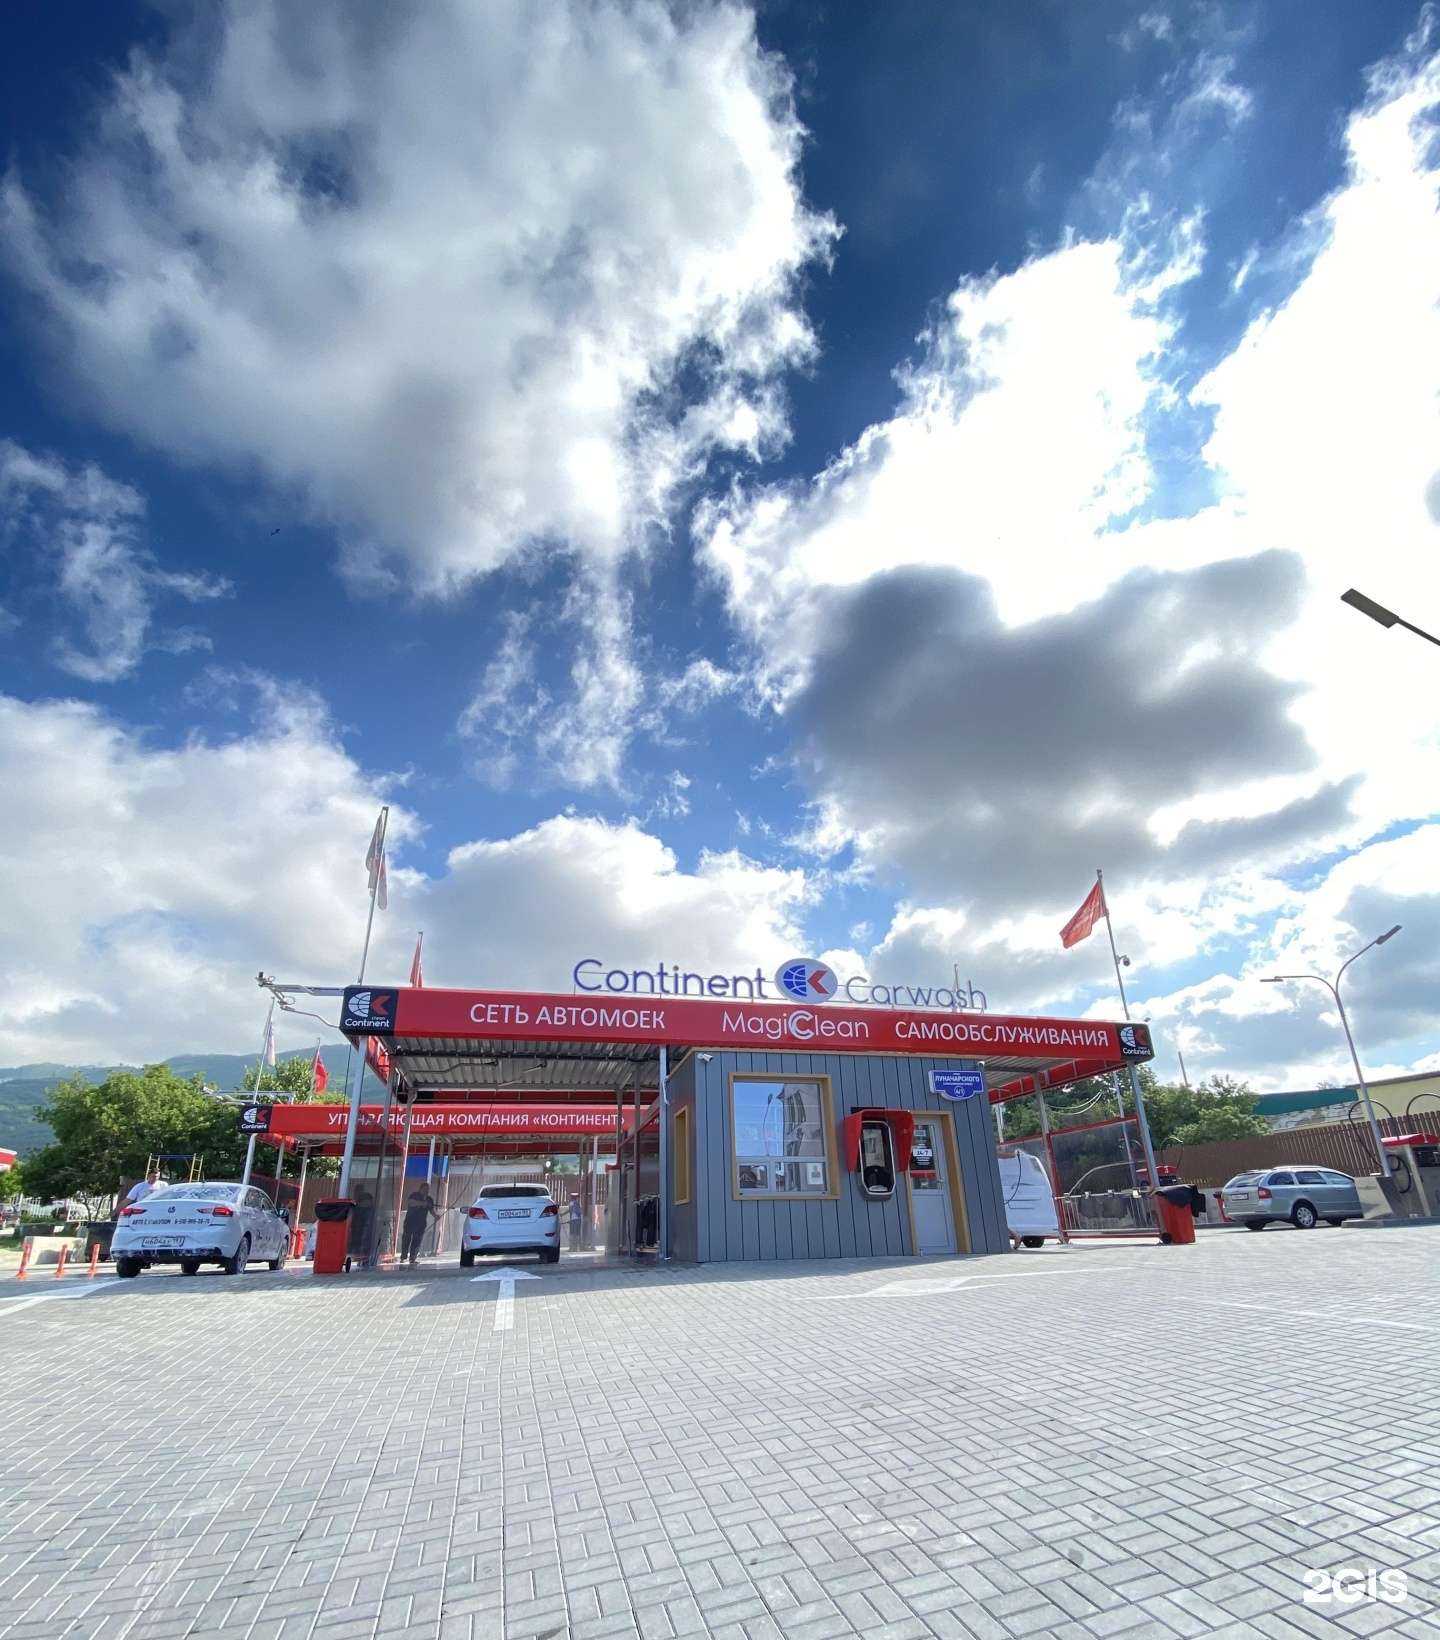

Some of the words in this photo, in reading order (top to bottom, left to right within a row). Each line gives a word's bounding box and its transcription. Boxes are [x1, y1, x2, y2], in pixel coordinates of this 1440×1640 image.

[574, 959, 768, 999] Continent
[846, 976, 988, 1010] Carwash
[345, 1018, 390, 1028] Continent
[470, 1003, 529, 1024] СЕТЬ
[536, 1005, 665, 1029] АВТОМОЕК
[722, 1010, 869, 1040] MagiClean
[895, 1020, 1109, 1047] САМООБСЛУЖИВАНИЯ
[1122, 1047, 1151, 1056] Continent
[449, 1113, 529, 1126] КОМПАНИЯ
